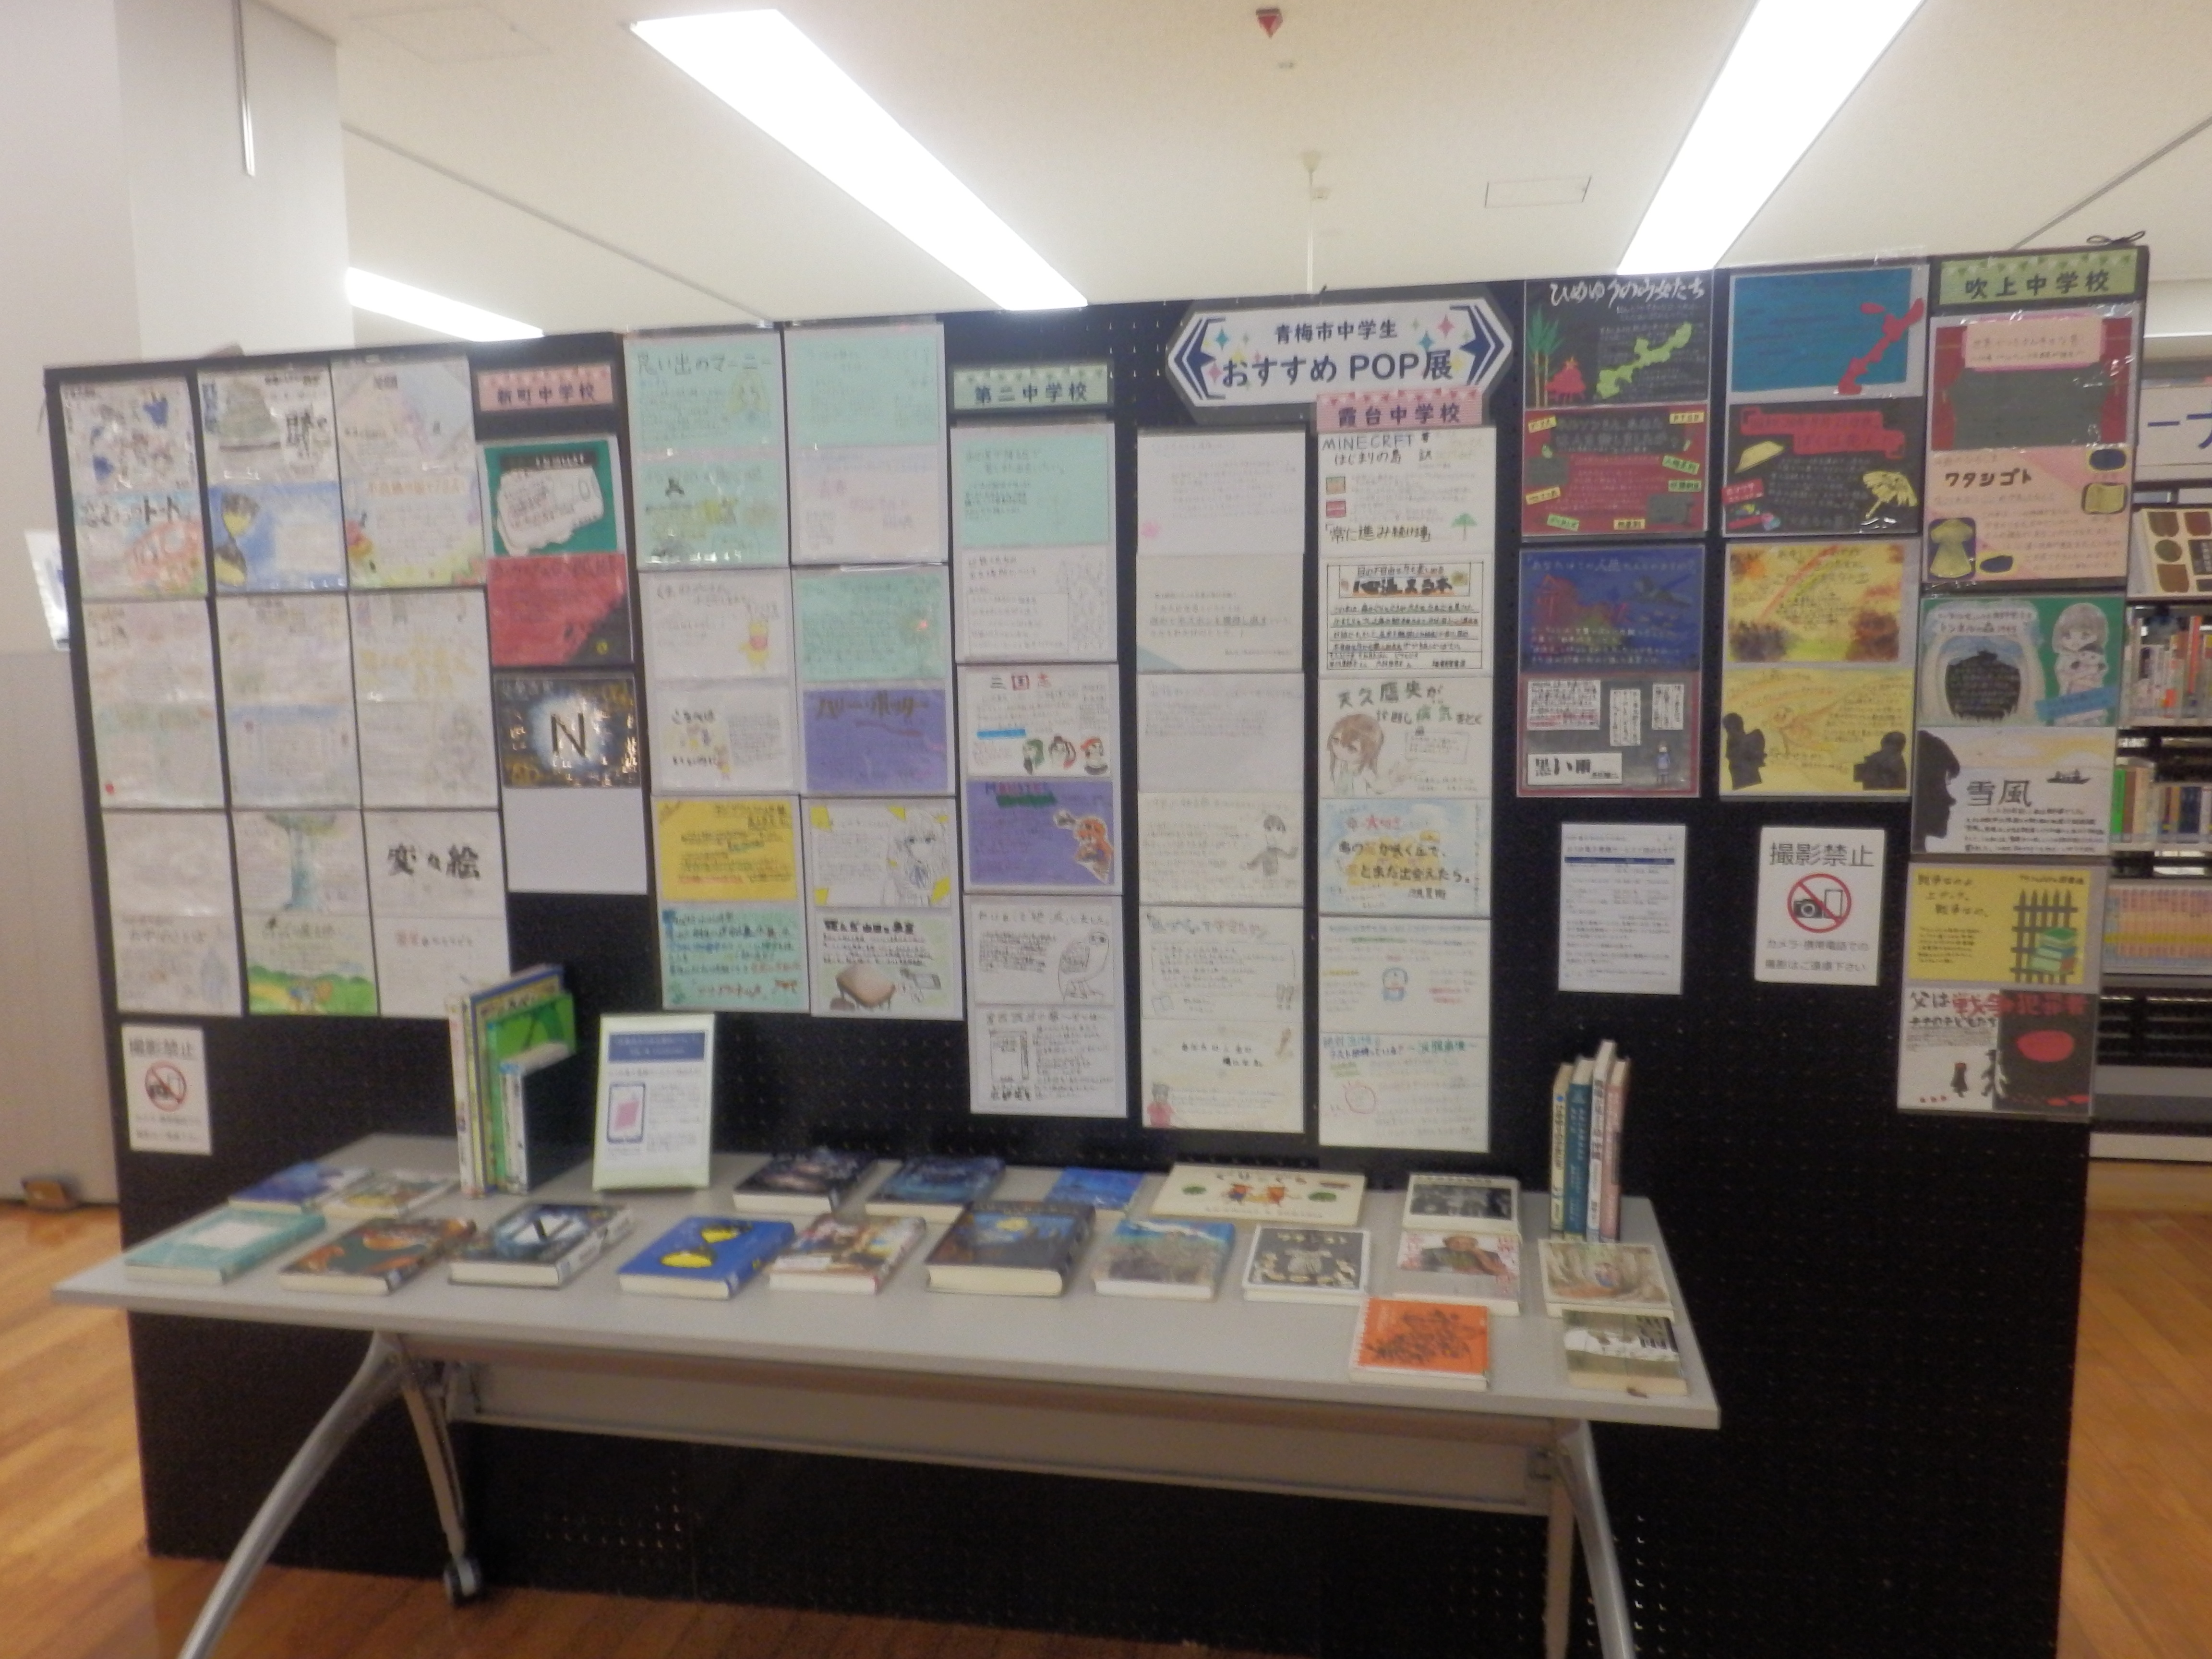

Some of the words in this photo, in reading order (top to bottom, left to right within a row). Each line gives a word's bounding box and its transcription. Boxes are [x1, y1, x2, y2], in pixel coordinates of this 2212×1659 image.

[1965, 271, 2109, 300] 吹上中学校
[1275, 319, 1397, 344] 青梅市中学生
[1339, 404, 1460, 428] 霞台中学校
[1945, 468, 2032, 488] ワタシゴト
[551, 712, 587, 757] N
[1967, 780, 2032, 806] 雪風
[1769, 843, 1874, 867] 撮影禁止
